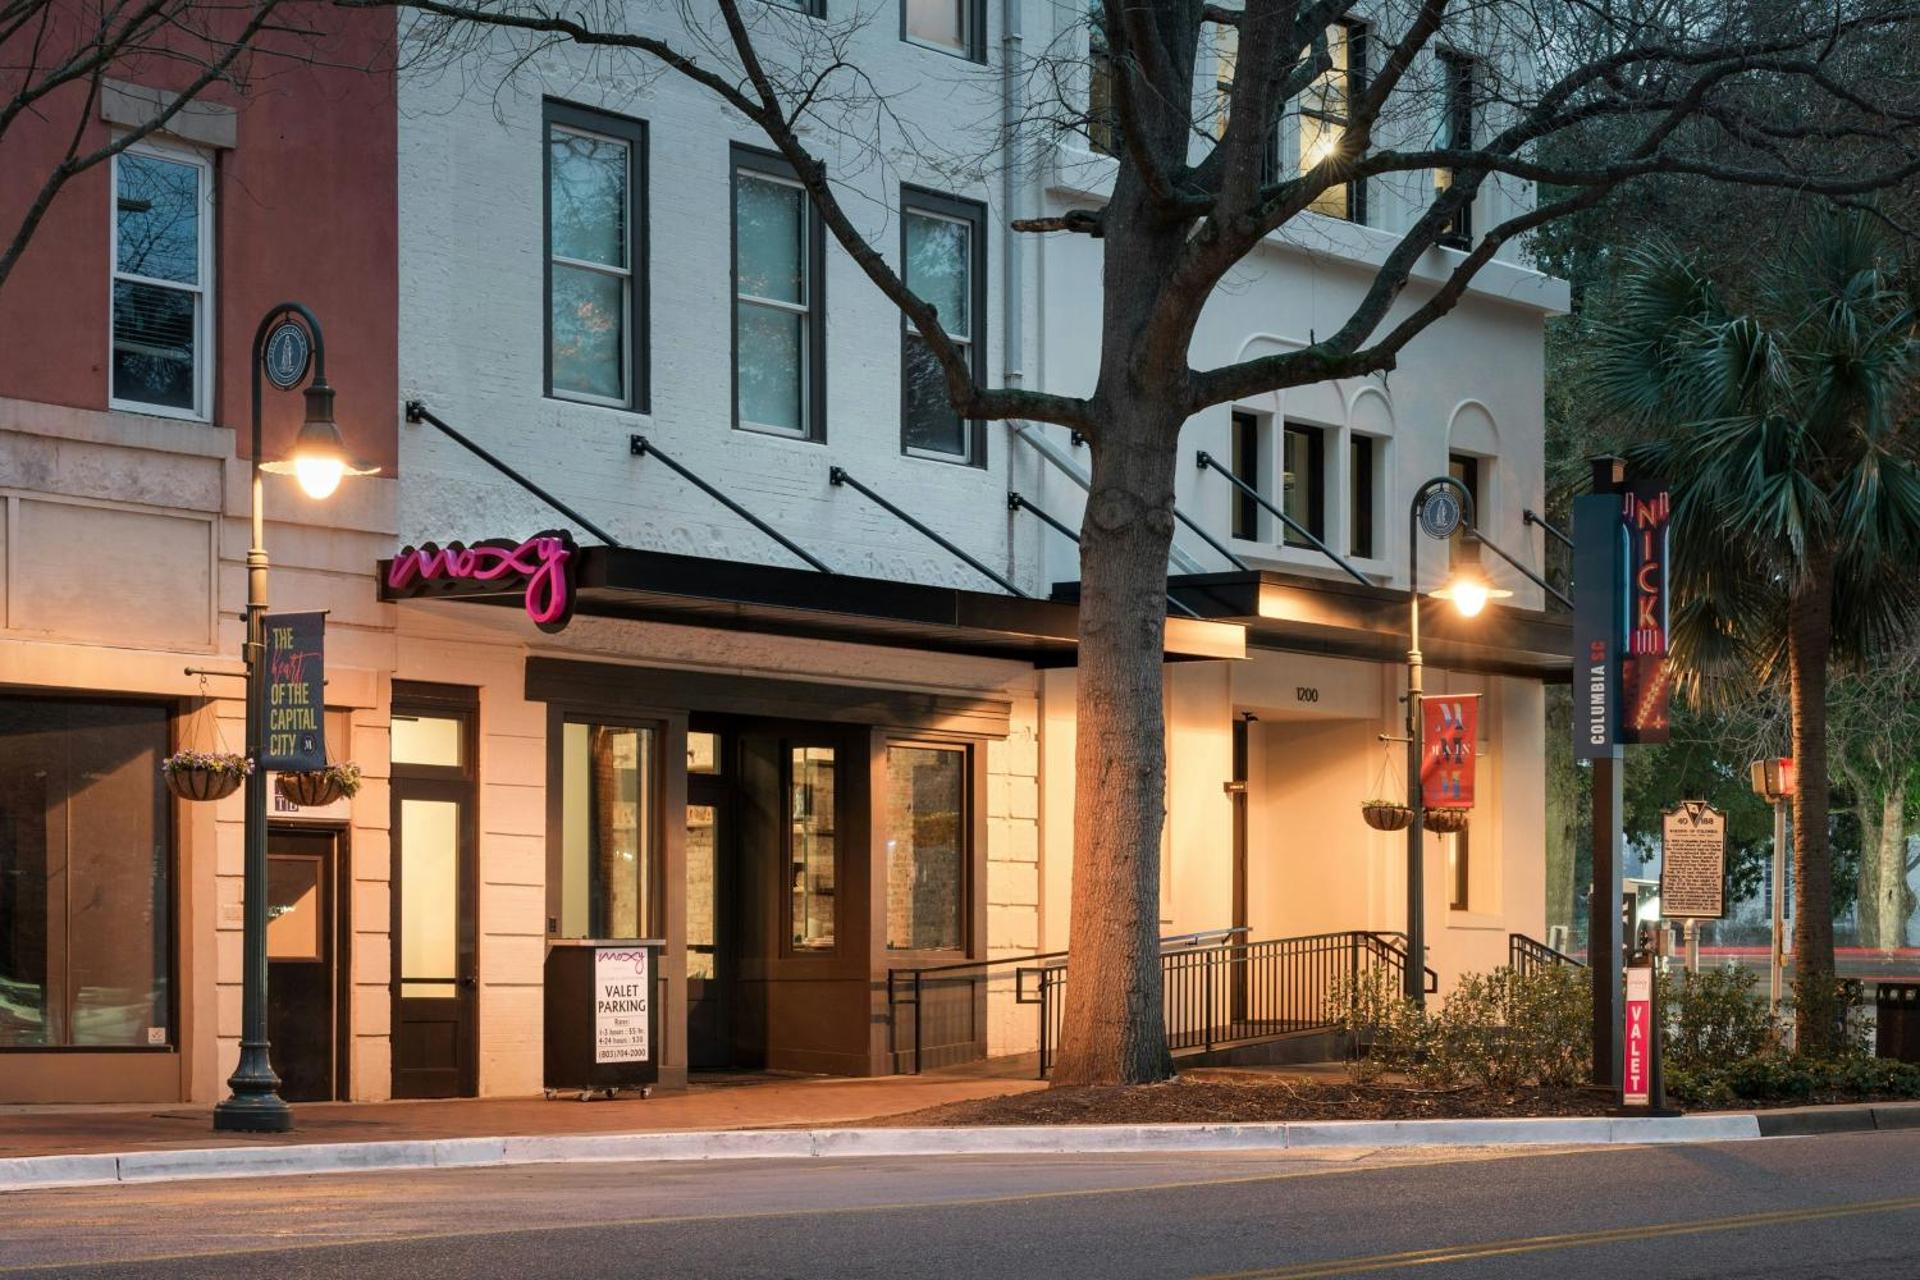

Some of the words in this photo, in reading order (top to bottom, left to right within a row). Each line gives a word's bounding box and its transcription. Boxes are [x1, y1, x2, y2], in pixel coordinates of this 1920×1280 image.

[1636, 500, 1658, 630] NICK
[388, 537, 571, 623] moxy
[272, 627, 294, 650] THE
[1590, 640, 1606, 661] SC
[271, 649, 321, 684] heart
[270, 683, 285, 705] OF
[288, 683, 309, 705] THE
[1296, 686, 1319, 702] 1200
[1590, 665, 1606, 745] COLUMBIA
[270, 708, 318, 731] CAPITAL
[270, 733, 297, 757] CITY
[599, 951, 645, 975] moxy
[605, 985, 639, 997] VALET
[598, 1000, 646, 1013] PARKING
[599, 1037, 611, 1045] 4-24
[1630, 1005, 1642, 1092] VALET
